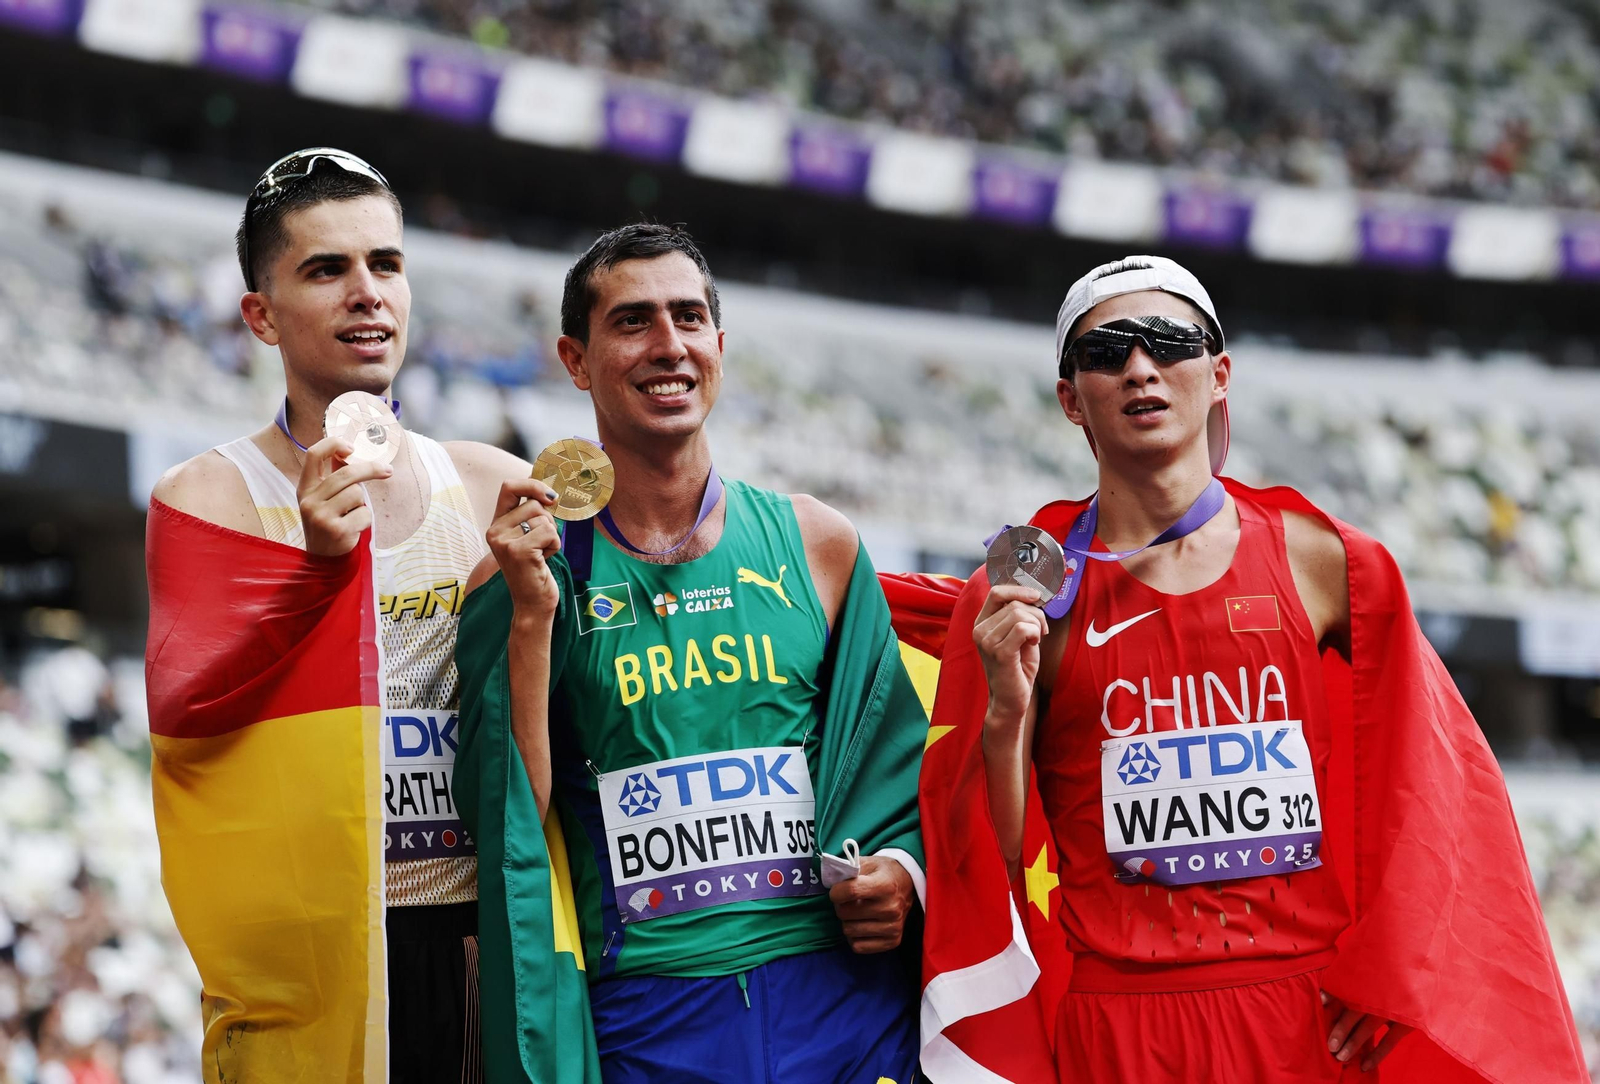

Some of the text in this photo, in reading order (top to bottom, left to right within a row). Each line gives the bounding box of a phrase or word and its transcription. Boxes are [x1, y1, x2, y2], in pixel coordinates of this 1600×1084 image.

[379, 578, 466, 622] PAÑ
[681, 584, 731, 600] loterias
[685, 596, 735, 614] CAIXA
[614, 633, 789, 706] BRASIL
[1100, 664, 1289, 738] CHINA
[385, 716, 459, 758] DK
[1157, 727, 1298, 780] TDK
[656, 753, 800, 807] TDK
[1113, 786, 1317, 845] WANG 312
[617, 810, 779, 879] BONFIM
[1164, 843, 1313, 874] TOKYO 25
[672, 867, 820, 902] TOKYO 25
